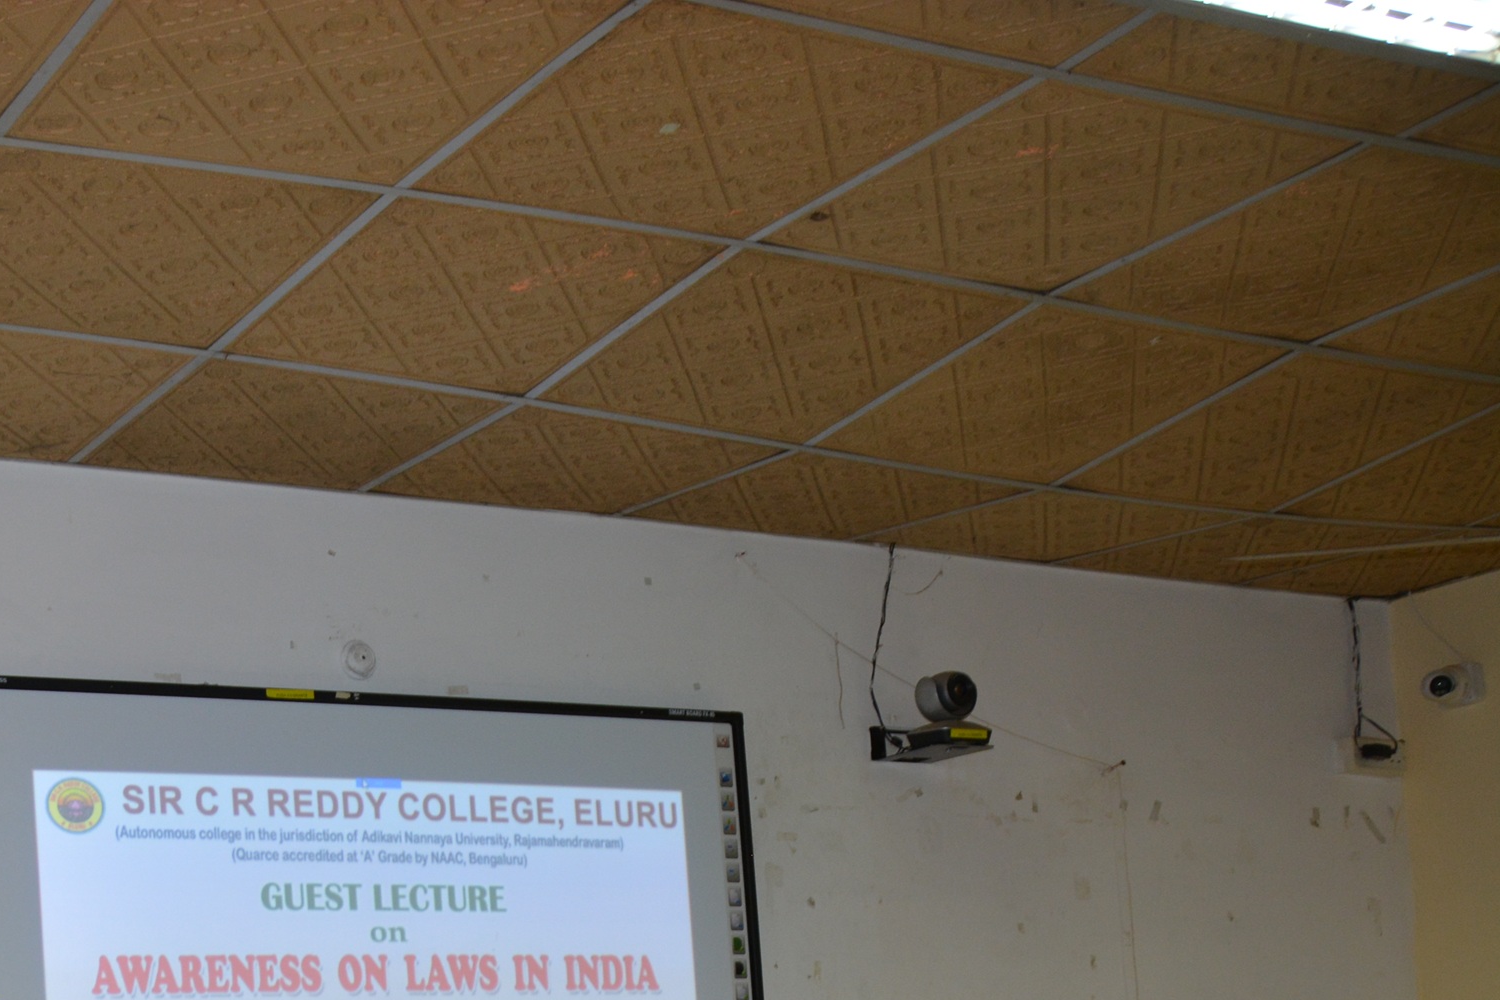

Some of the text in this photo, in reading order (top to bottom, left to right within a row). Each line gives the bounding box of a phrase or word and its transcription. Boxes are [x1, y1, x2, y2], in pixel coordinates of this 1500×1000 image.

[122, 784, 184, 815] SIR
[195, 786, 220, 817] C
[231, 787, 257, 817] R
[267, 788, 387, 820] REDDY
[398, 792, 565, 829] COLLEGE,
[574, 798, 678, 829] ELURU
[115, 825, 624, 851] (Autonomous college in the jurisdiction of Adikavi Nannaya University, Rajamahendravaram)
[231, 847, 280, 864] (Quarce
[282, 848, 344, 863] accredited
[346, 849, 359, 863] at
[378, 851, 412, 865] Grade
[415, 852, 428, 868] by
[431, 852, 466, 867] NAAC,
[469, 853, 528, 868] Bengaluru)
[260, 882, 507, 912] GUEST LECTURE
[370, 925, 408, 942] on
[91, 953, 661, 996] AWARENESS ON LAWS IN INDIA
